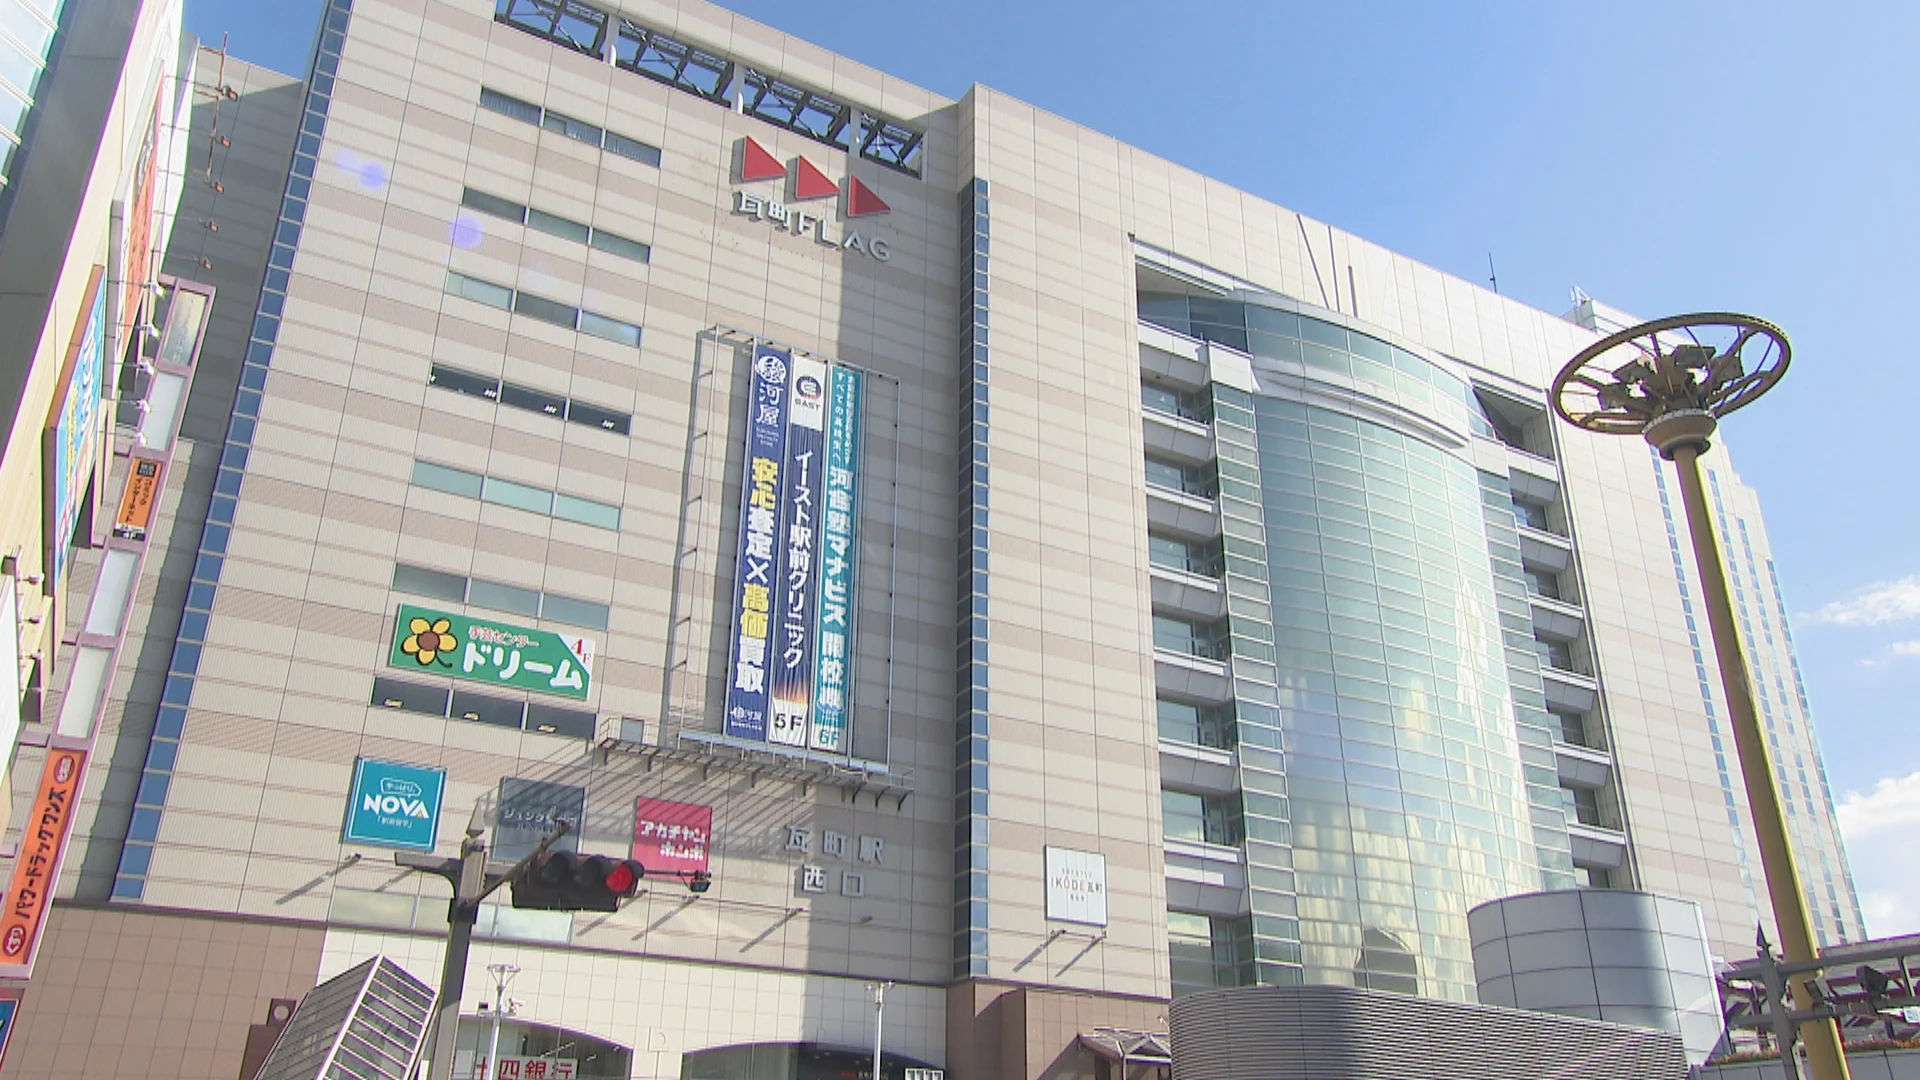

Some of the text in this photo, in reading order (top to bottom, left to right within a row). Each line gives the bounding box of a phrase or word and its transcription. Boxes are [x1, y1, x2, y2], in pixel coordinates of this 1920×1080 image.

[738, 190, 892, 262] 瓦町FLAG
[755, 355, 787, 427] 駿河屋
[782, 450, 815, 669] イースト駅前クリニック
[823, 466, 855, 628] 河合塾マナビス
[735, 457, 779, 695] 安心査定×高価買取
[463, 642, 583, 689] ドリーム
[363, 792, 430, 819] NOVA
[640, 820, 706, 844] アカチャン
[785, 825, 884, 864] 瓦町駅
[802, 864, 865, 897] 西口
[6, 926, 24, 955] くすり
